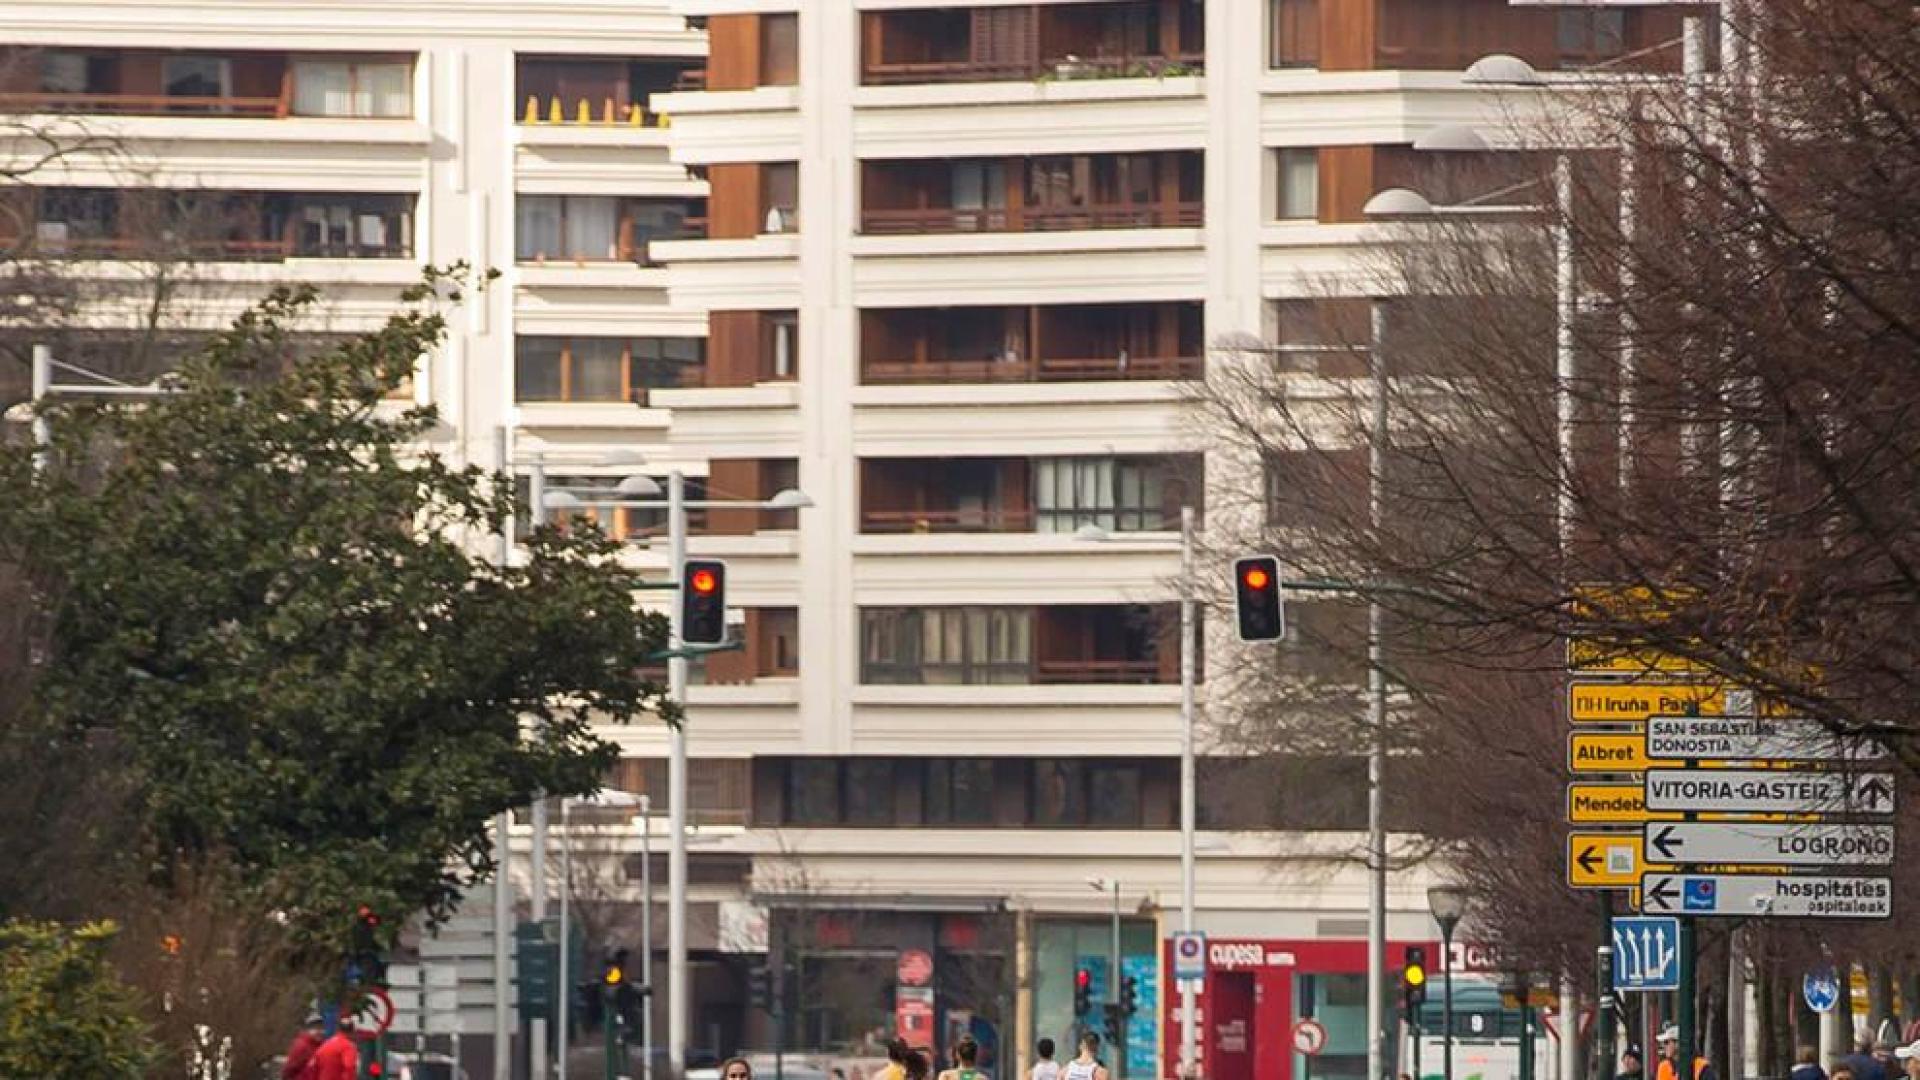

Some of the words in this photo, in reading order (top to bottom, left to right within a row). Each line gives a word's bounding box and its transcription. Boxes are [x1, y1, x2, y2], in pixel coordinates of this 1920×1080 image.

[1605, 697, 1649, 712] Iruña
[1653, 722, 1686, 735] SAN
[1577, 744, 1634, 760] Albret
[1653, 739, 1731, 752] DONOSTIA
[1652, 782, 1830, 800] VITORIA-GASTEIZ
[1776, 880, 1886, 900] hospitales
